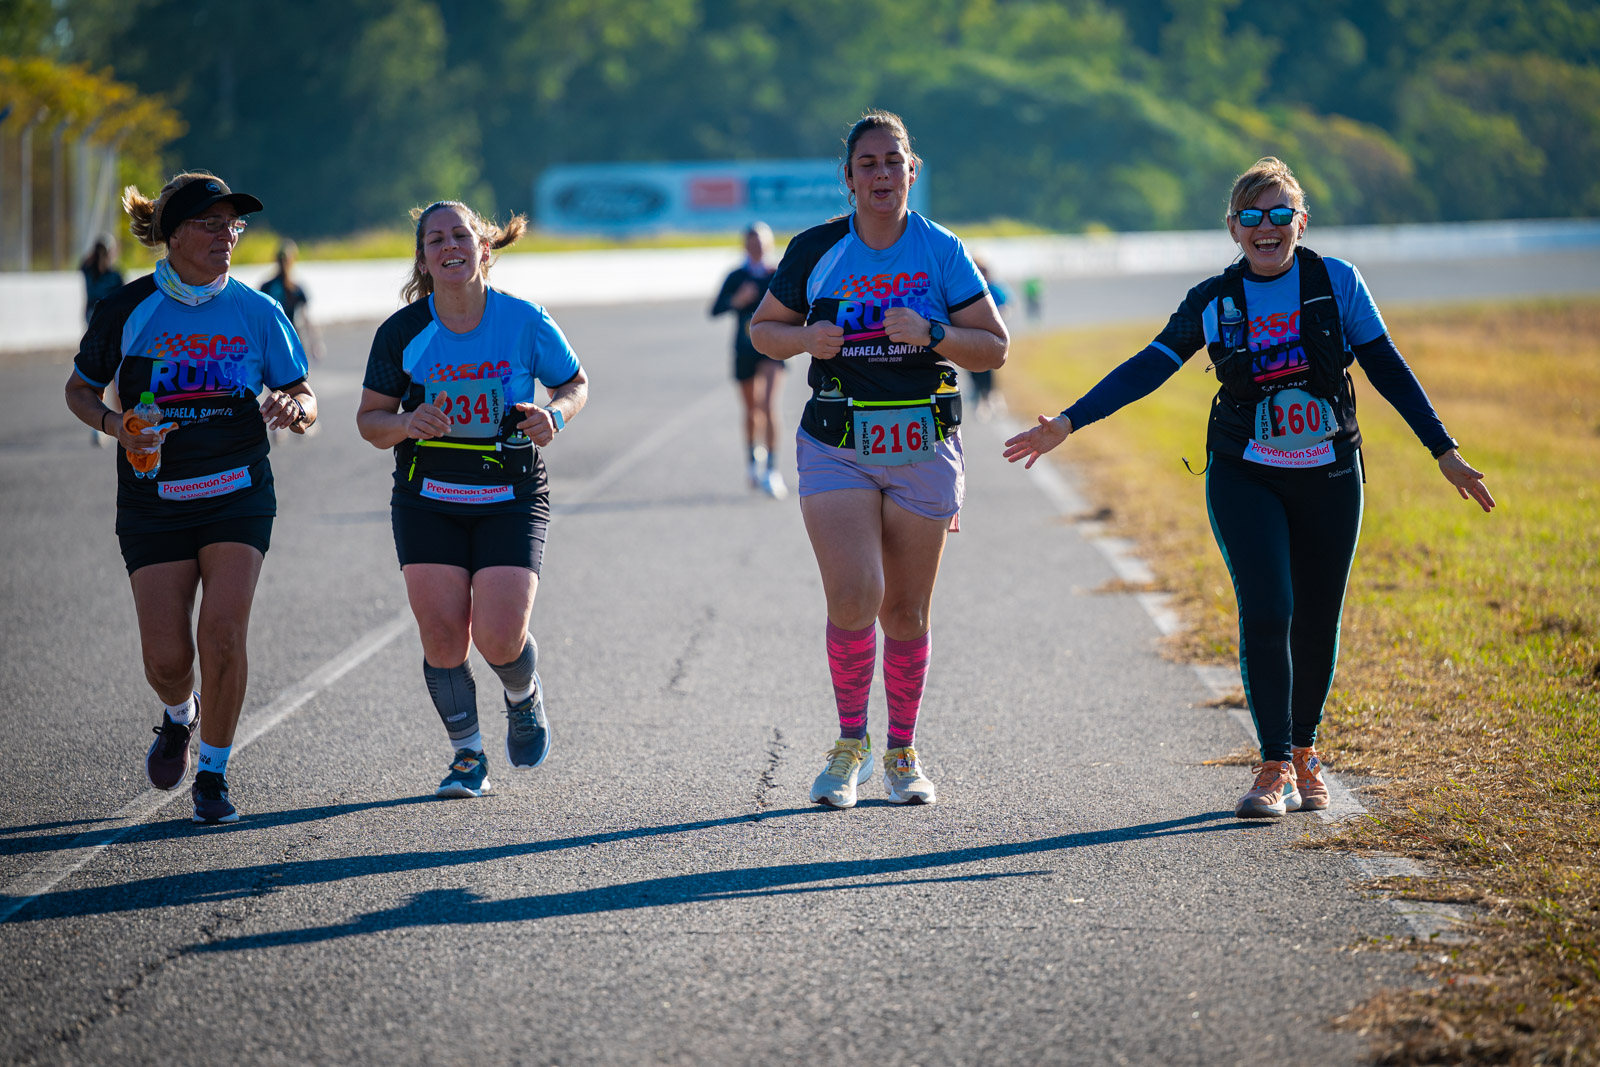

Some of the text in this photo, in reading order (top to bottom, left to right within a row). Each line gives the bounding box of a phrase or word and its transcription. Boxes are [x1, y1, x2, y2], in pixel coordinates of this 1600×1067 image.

[220, 346, 249, 354] MILLAS
[842, 345, 885, 357] RAFAELA,
[887, 344, 917, 355] SANTA
[149, 360, 233, 393] RUN
[441, 393, 491, 425] 234
[491, 388, 500, 425] EXACTO
[1261, 402, 1269, 440] TIEMPO
[1271, 400, 1321, 437] 260
[1320, 398, 1332, 432] XACTO
[861, 421, 870, 456] TIEMPO
[870, 421, 922, 454] 216
[920, 416, 929, 452] EXACTO
[1251, 442, 1330, 459] Prevención Salud
[1270, 458, 1293, 466] SANCOR
[163, 469, 245, 493] Prevención Salud
[187, 490, 210, 499] SANCOR
[210, 484, 235, 495] SEGUROS
[426, 482, 480, 496] Prevención
